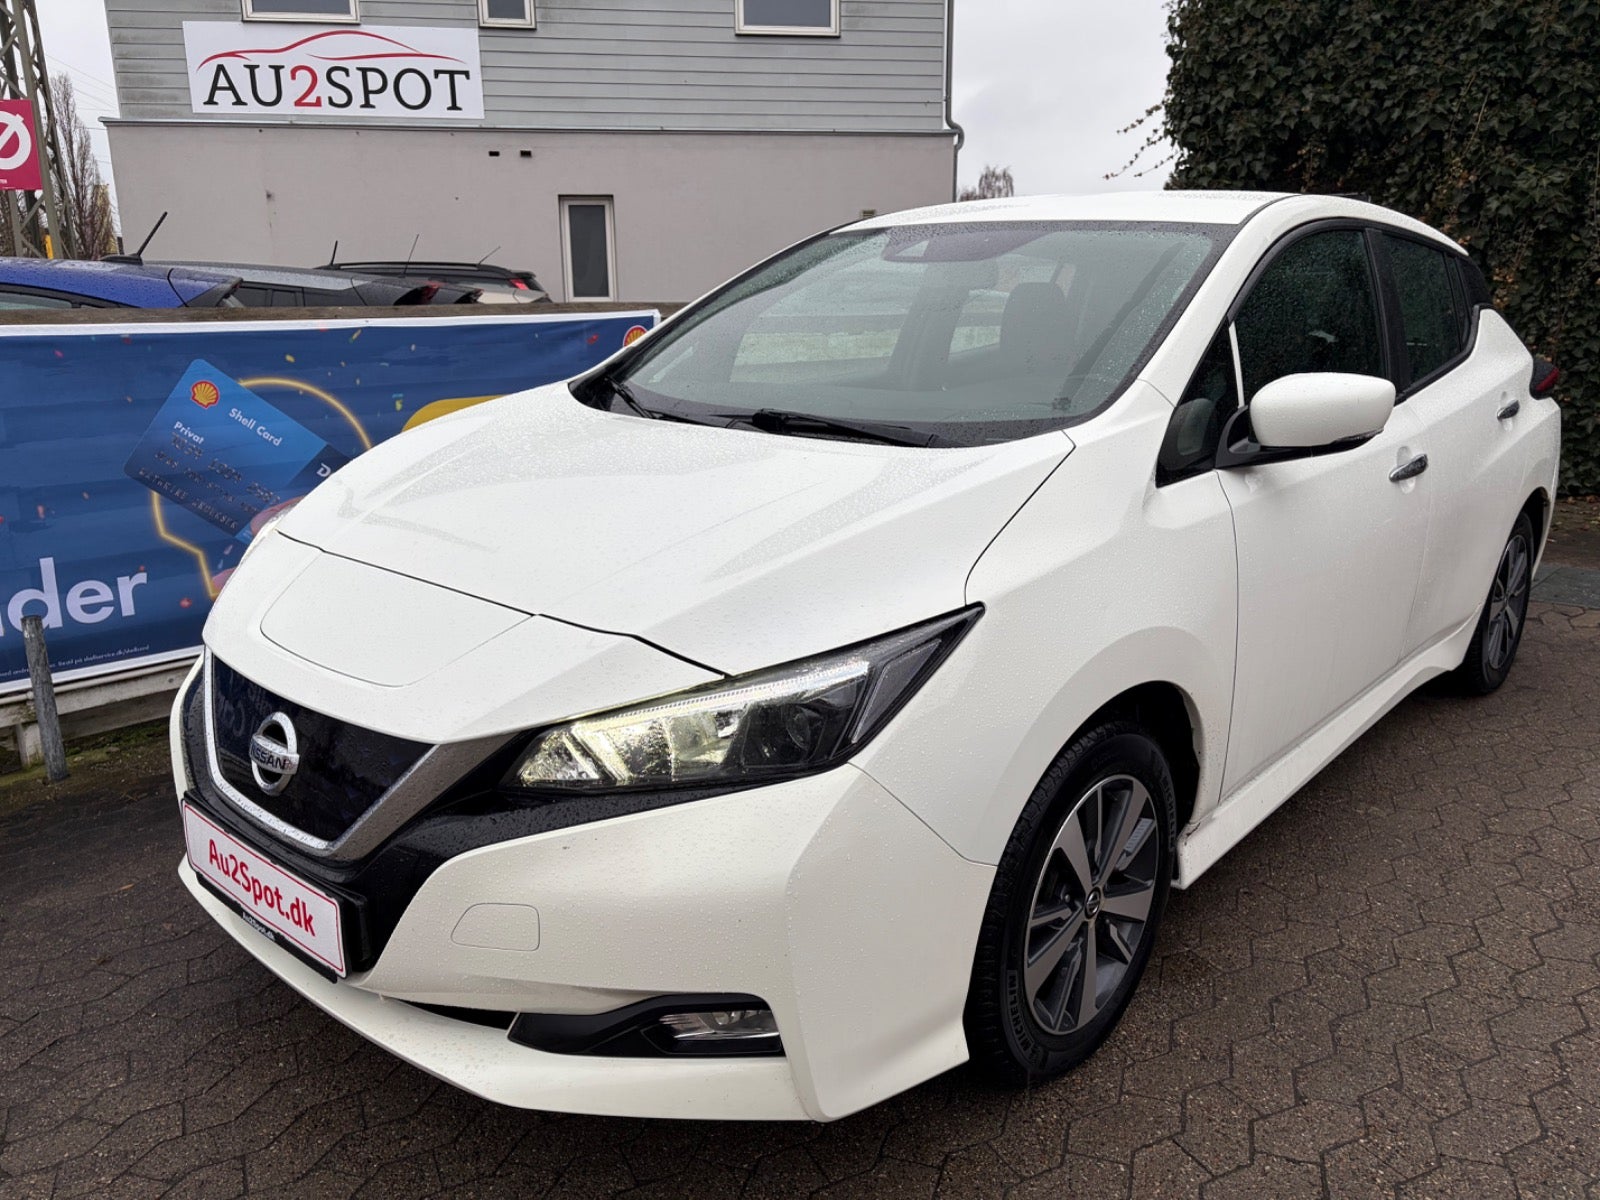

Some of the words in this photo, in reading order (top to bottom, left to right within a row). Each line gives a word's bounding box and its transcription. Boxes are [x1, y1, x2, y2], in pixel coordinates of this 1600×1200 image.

[203, 64, 470, 111] AU2SPOT
[173, 421, 204, 444] Privat
[229, 407, 256, 430] Shell
[256, 425, 283, 447] Card
[0, 557, 147, 637] der
[209, 838, 316, 937] Au2Spot.dk
[1008, 975, 1032, 1051] MICHELIN
